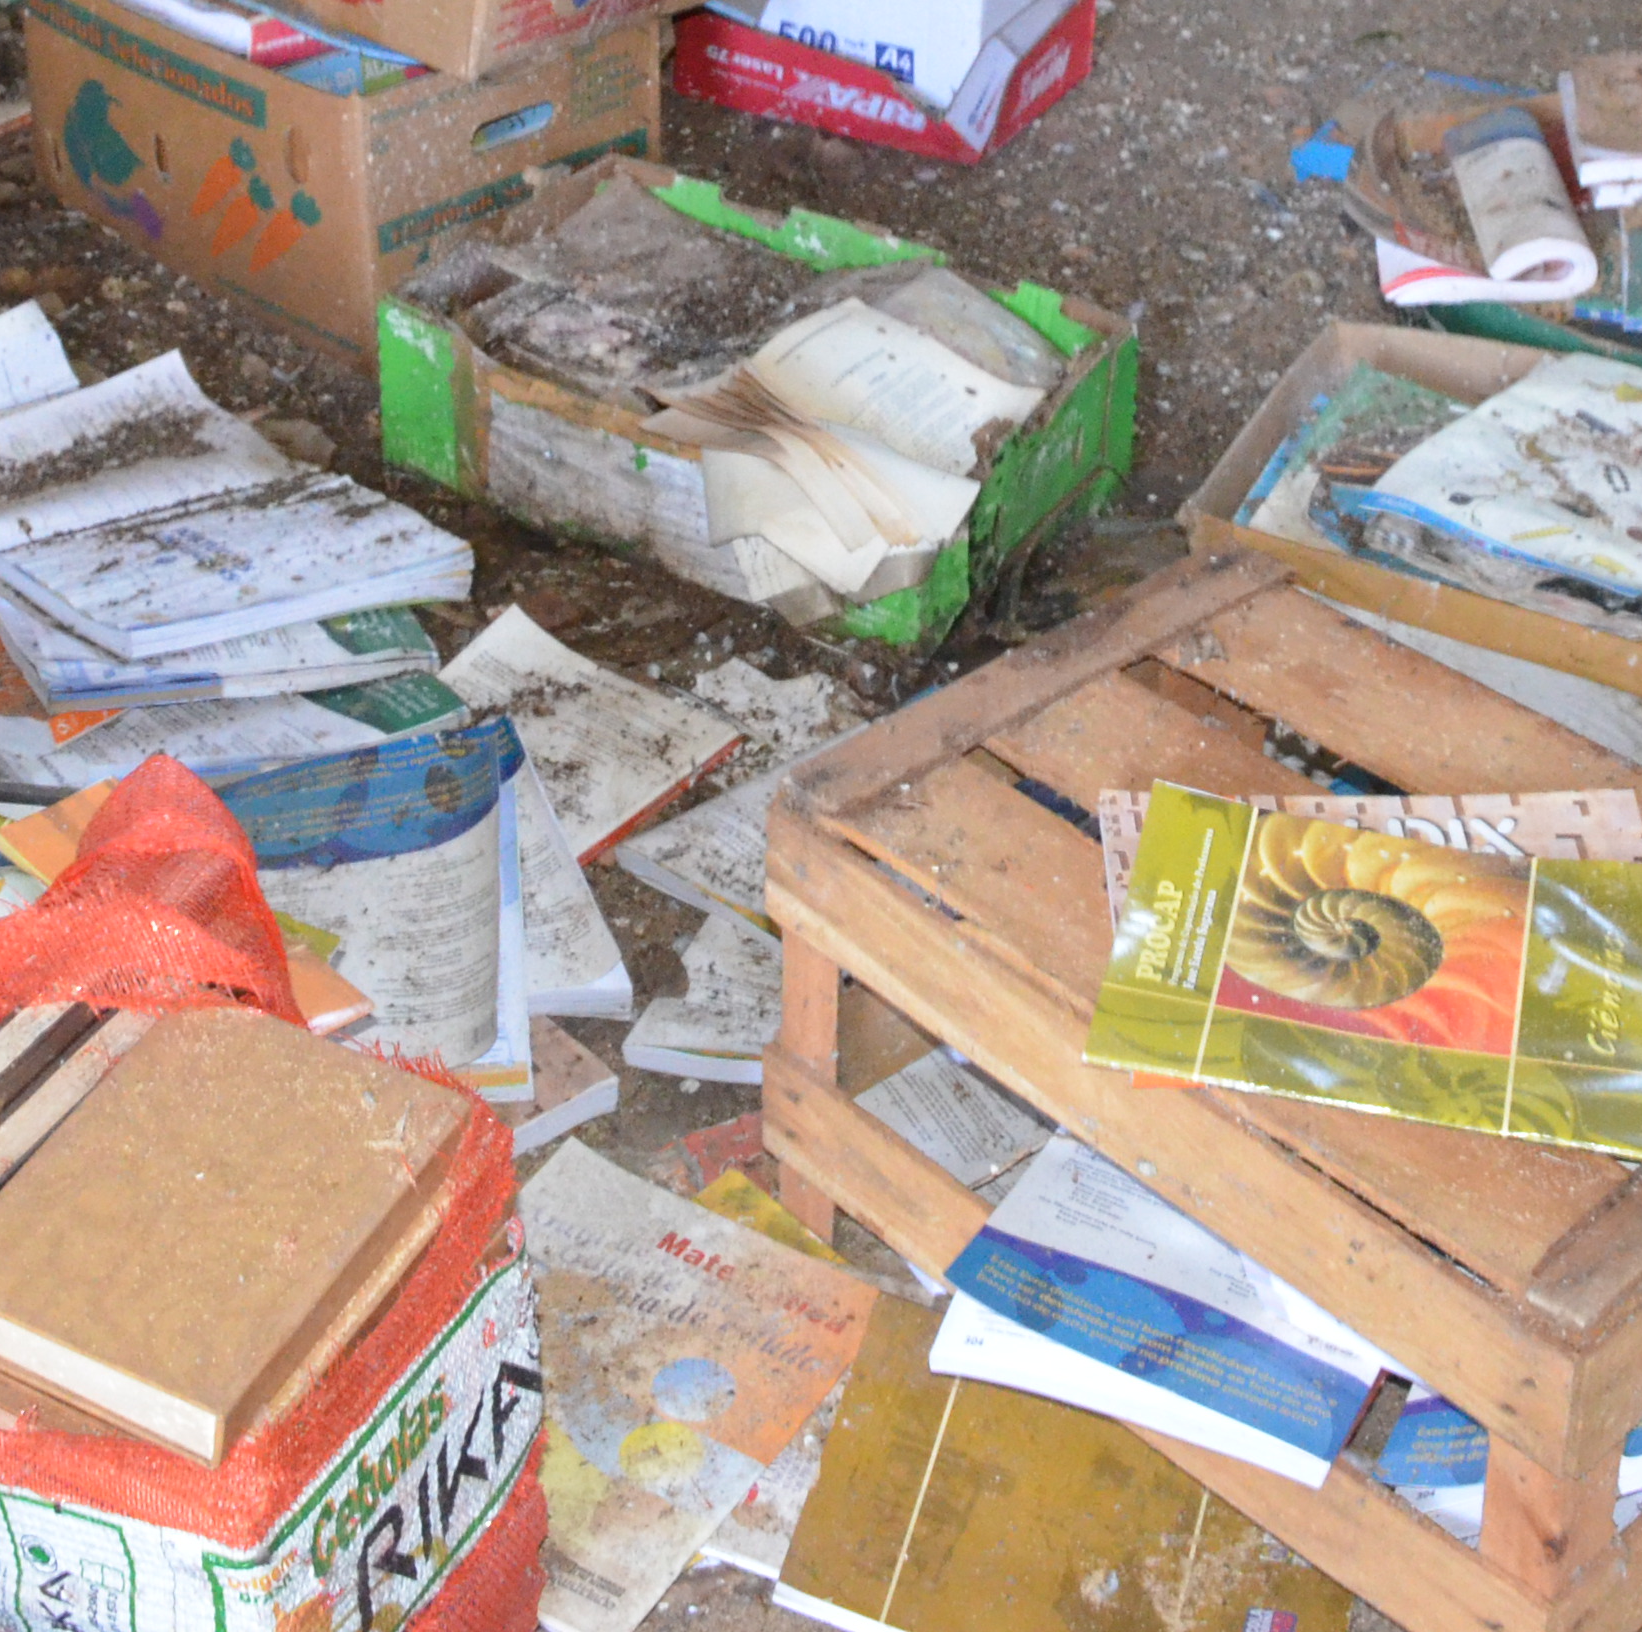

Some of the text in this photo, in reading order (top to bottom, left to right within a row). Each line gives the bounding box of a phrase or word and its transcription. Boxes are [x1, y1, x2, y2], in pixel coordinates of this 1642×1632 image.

[876, 42, 915, 76] A4
[1135, 879, 1184, 982] PROCAP
[311, 1374, 453, 1579] Cebolas
[357, 1361, 543, 1632] RIKA
